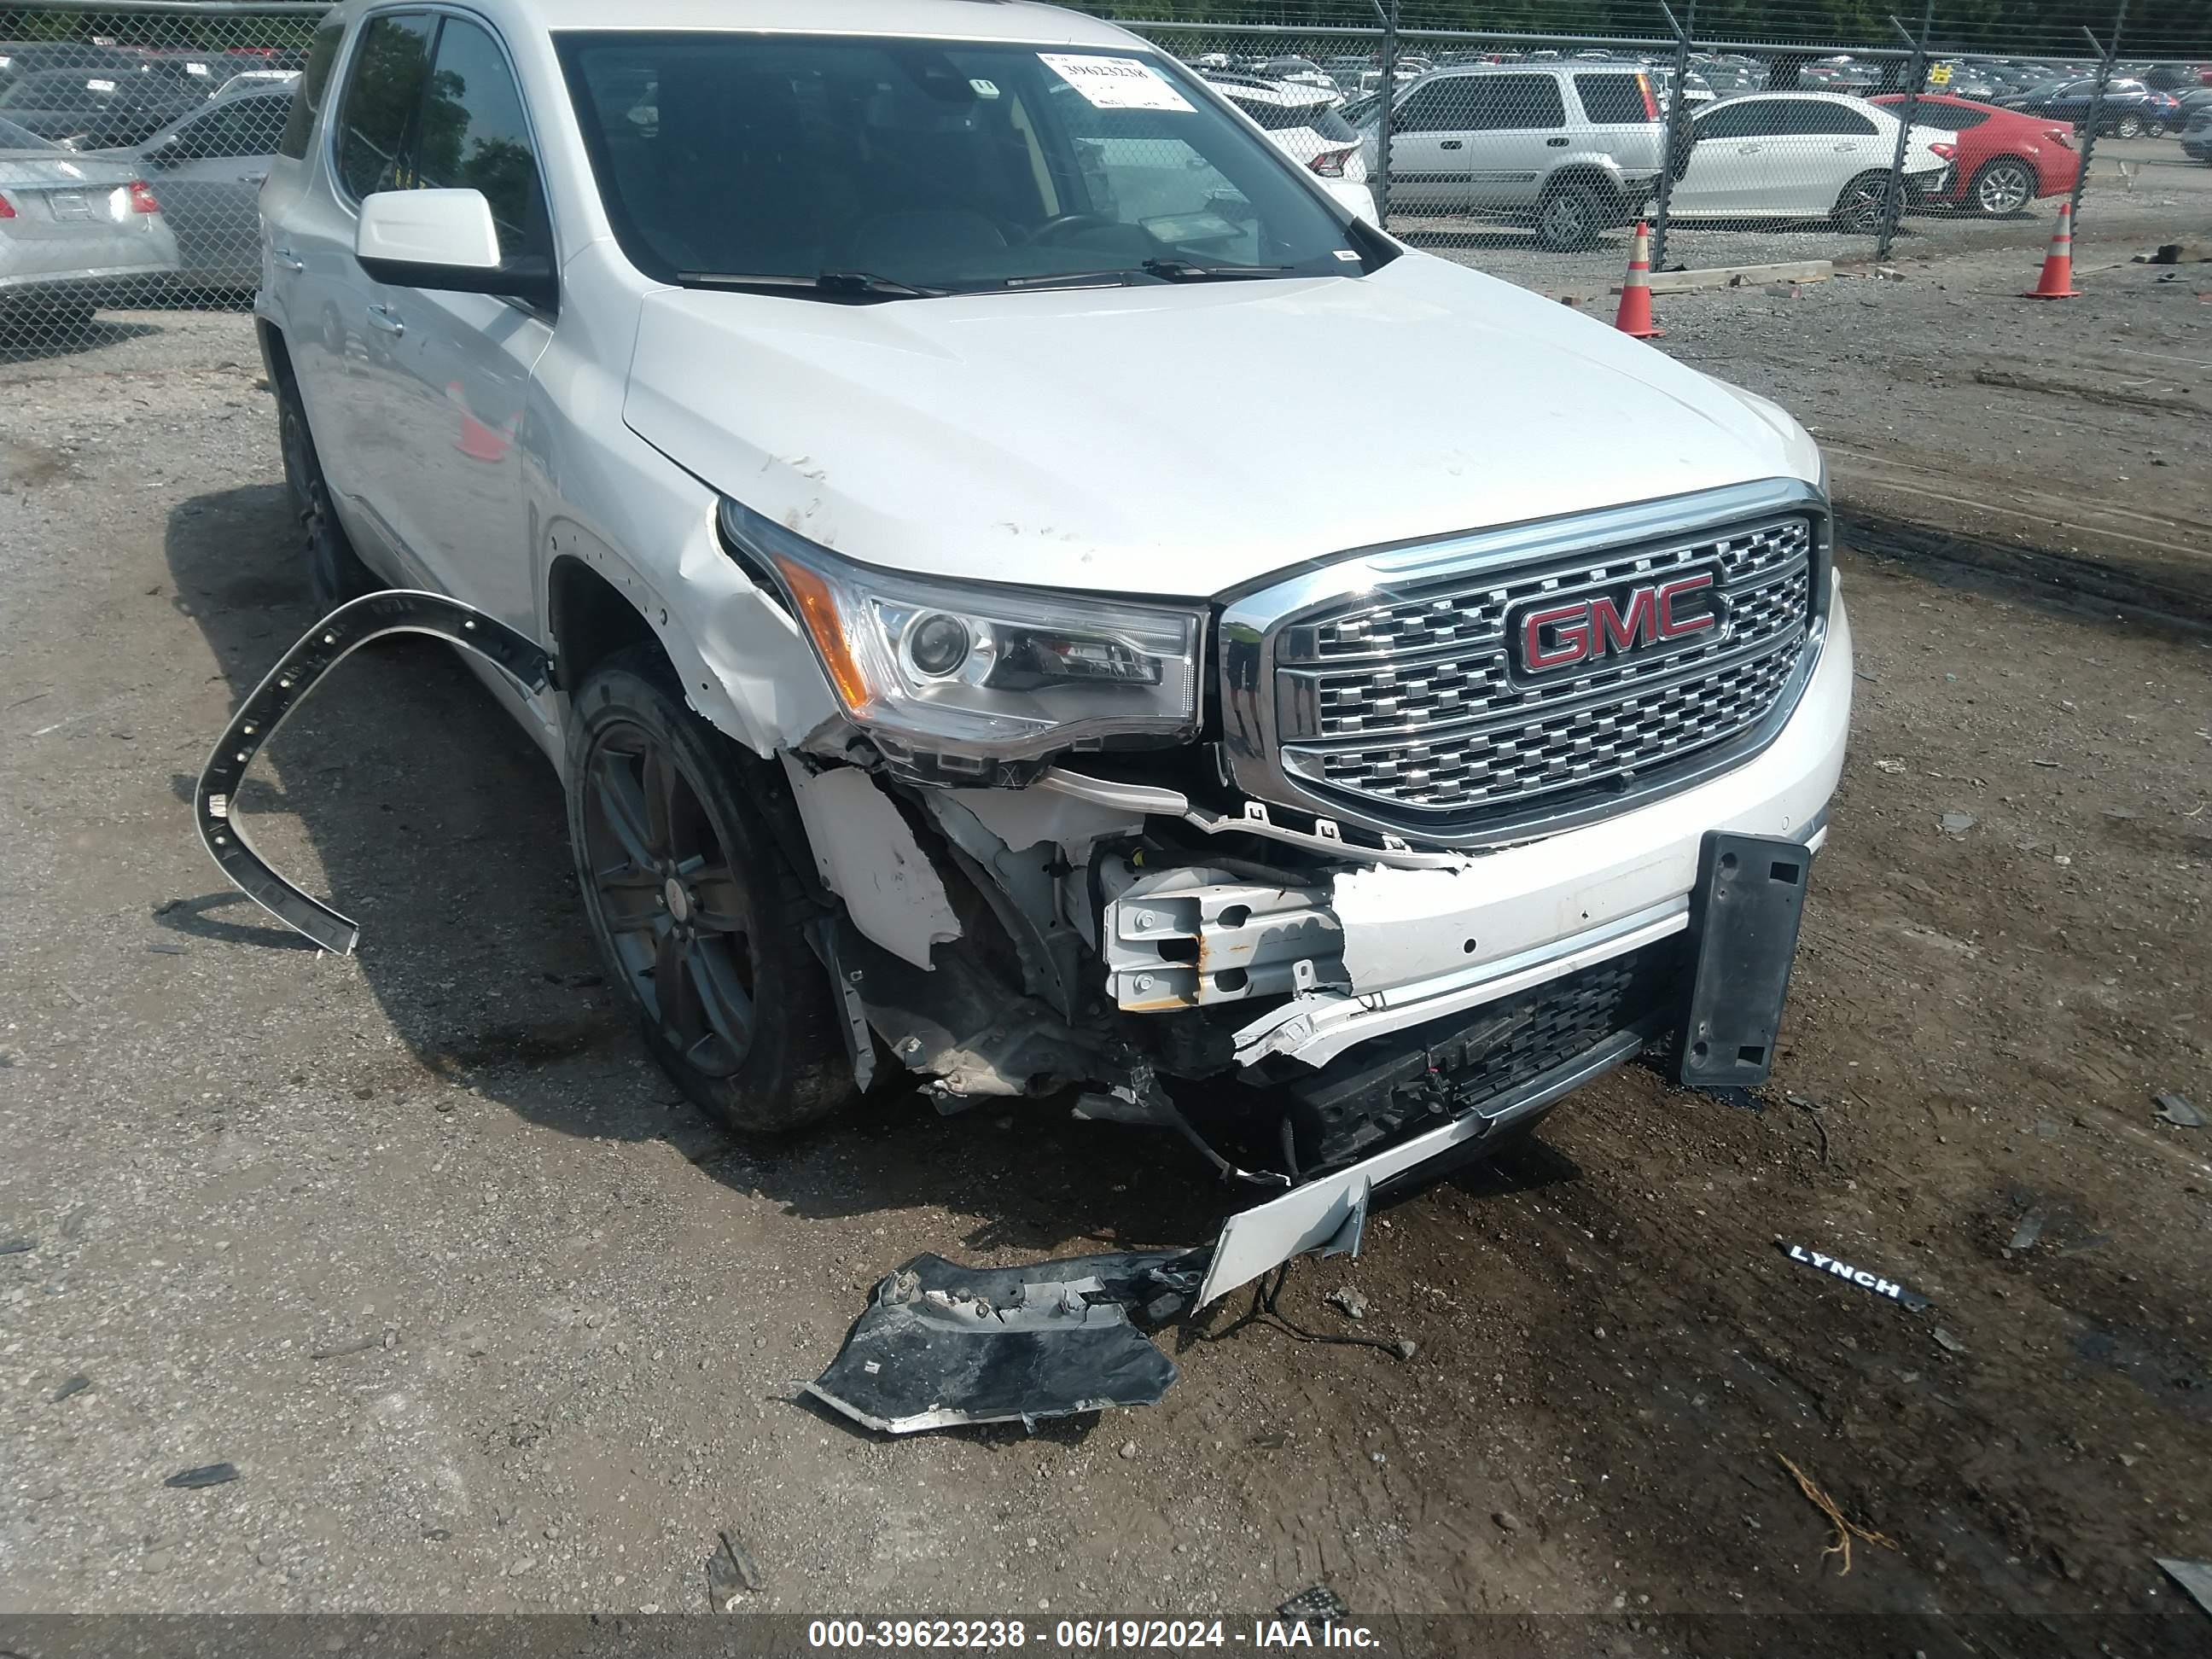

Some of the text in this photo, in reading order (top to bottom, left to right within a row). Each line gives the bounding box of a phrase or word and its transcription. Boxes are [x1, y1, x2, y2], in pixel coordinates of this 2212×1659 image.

[1063, 65, 1148, 79] 39623238
[1521, 573, 1714, 673] GMC
[1790, 1245, 1901, 1297] LYNCH
